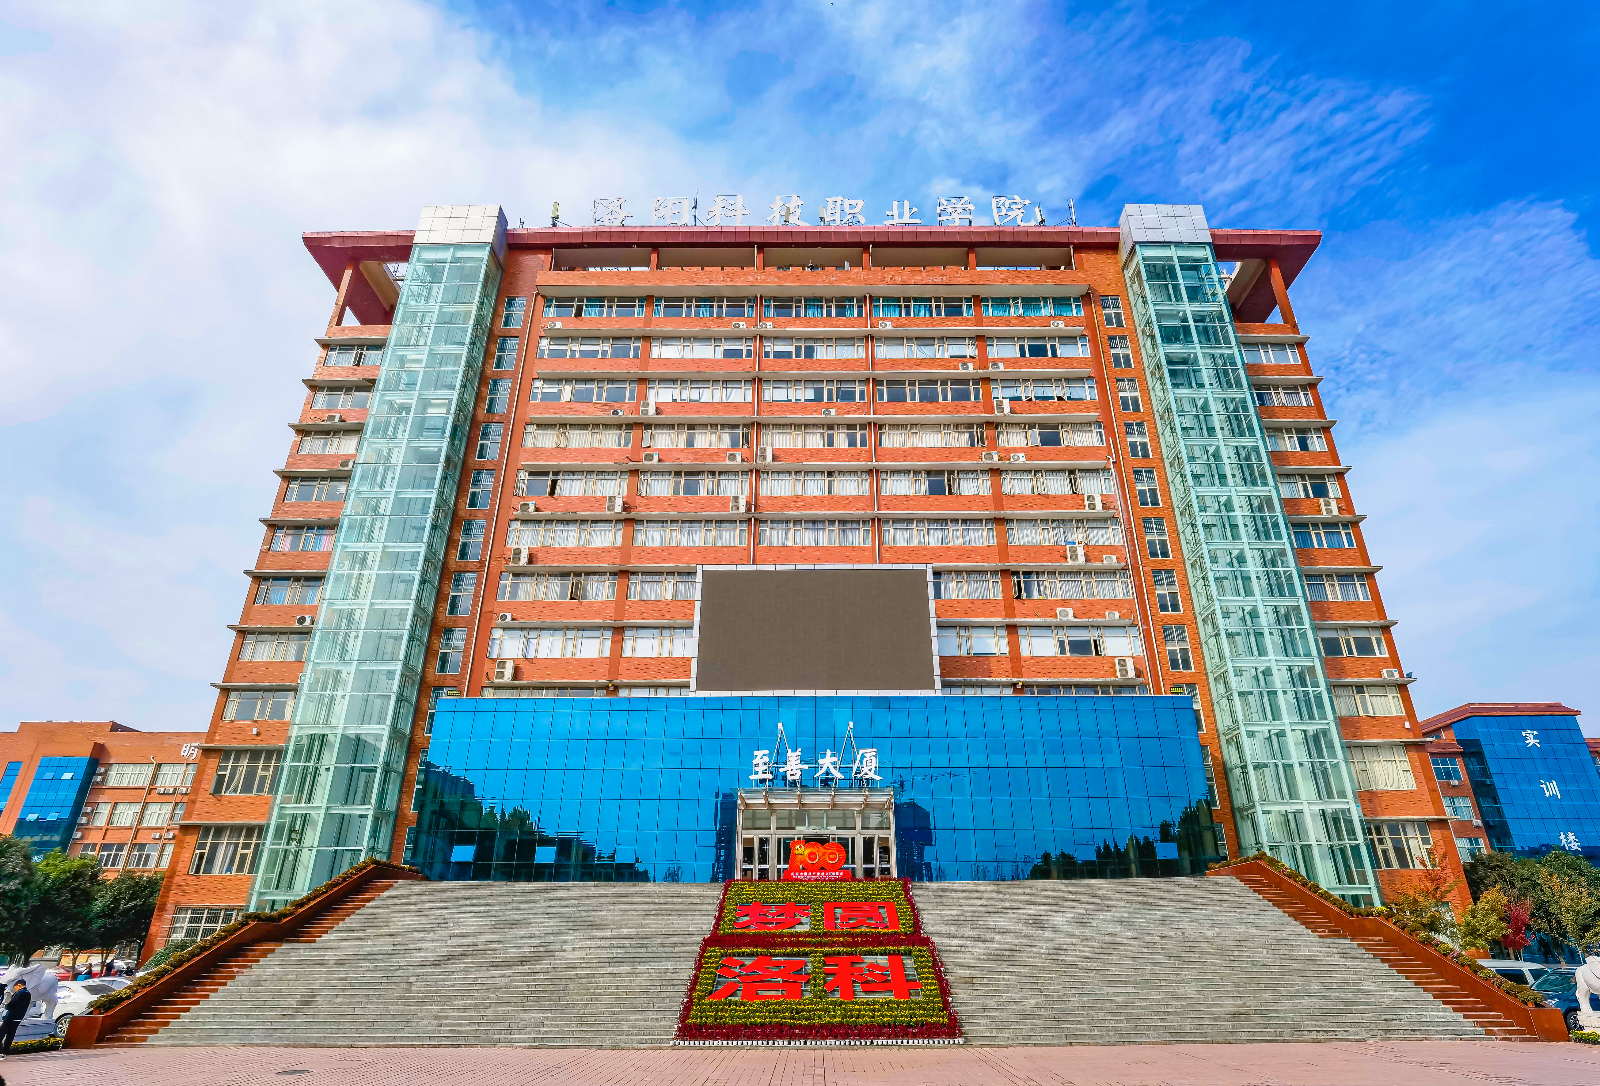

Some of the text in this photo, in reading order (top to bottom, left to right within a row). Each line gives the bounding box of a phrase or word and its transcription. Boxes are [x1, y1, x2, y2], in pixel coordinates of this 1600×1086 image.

[592, 194, 1036, 226] 洛阳科技职业学院
[749, 747, 883, 781] 至善大厦
[1521, 729, 1582, 851] 实训楼
[733, 901, 900, 931] 梦圆
[707, 954, 922, 1001] 洛科
